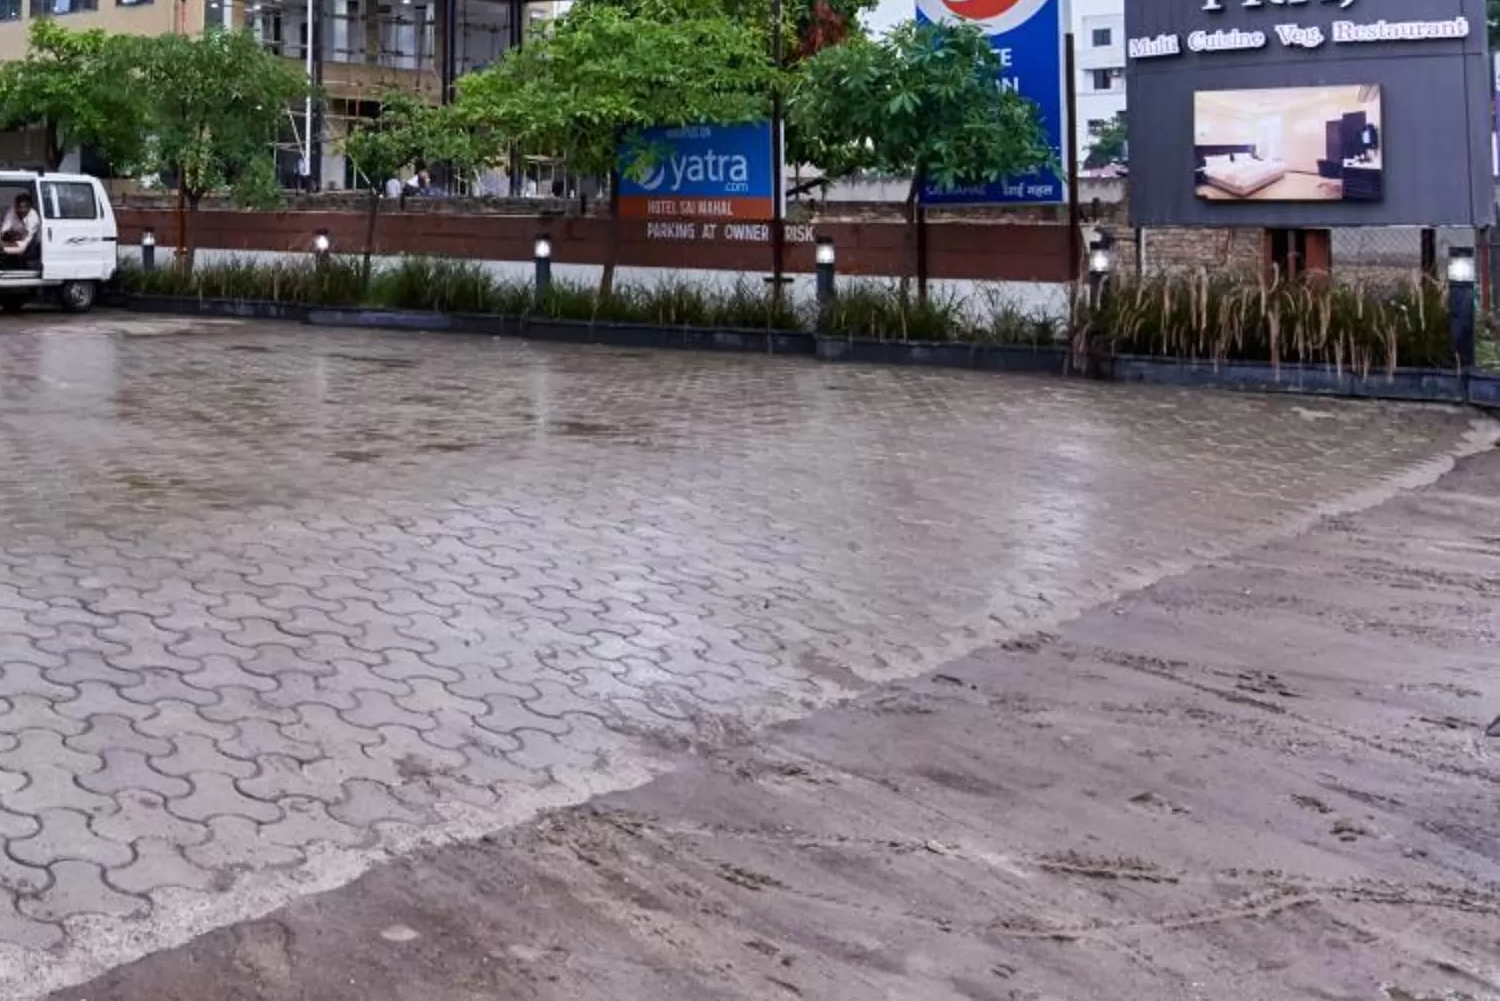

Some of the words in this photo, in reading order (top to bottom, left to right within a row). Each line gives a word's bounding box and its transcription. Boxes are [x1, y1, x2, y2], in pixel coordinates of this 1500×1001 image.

[1129, 35, 1179, 58] Multi
[1188, 28, 1266, 52] Cuisine
[1332, 17, 1469, 42] Restaurant
[670, 149, 748, 191] yatra
[647, 200, 678, 215] HOTEL
[680, 200, 696, 215] SAI
[698, 201, 734, 216] MAHAL
[647, 222, 695, 240] PARKING
[702, 224, 716, 240] AT
[724, 224, 769, 241] OWNER
[784, 225, 815, 242] RISK
